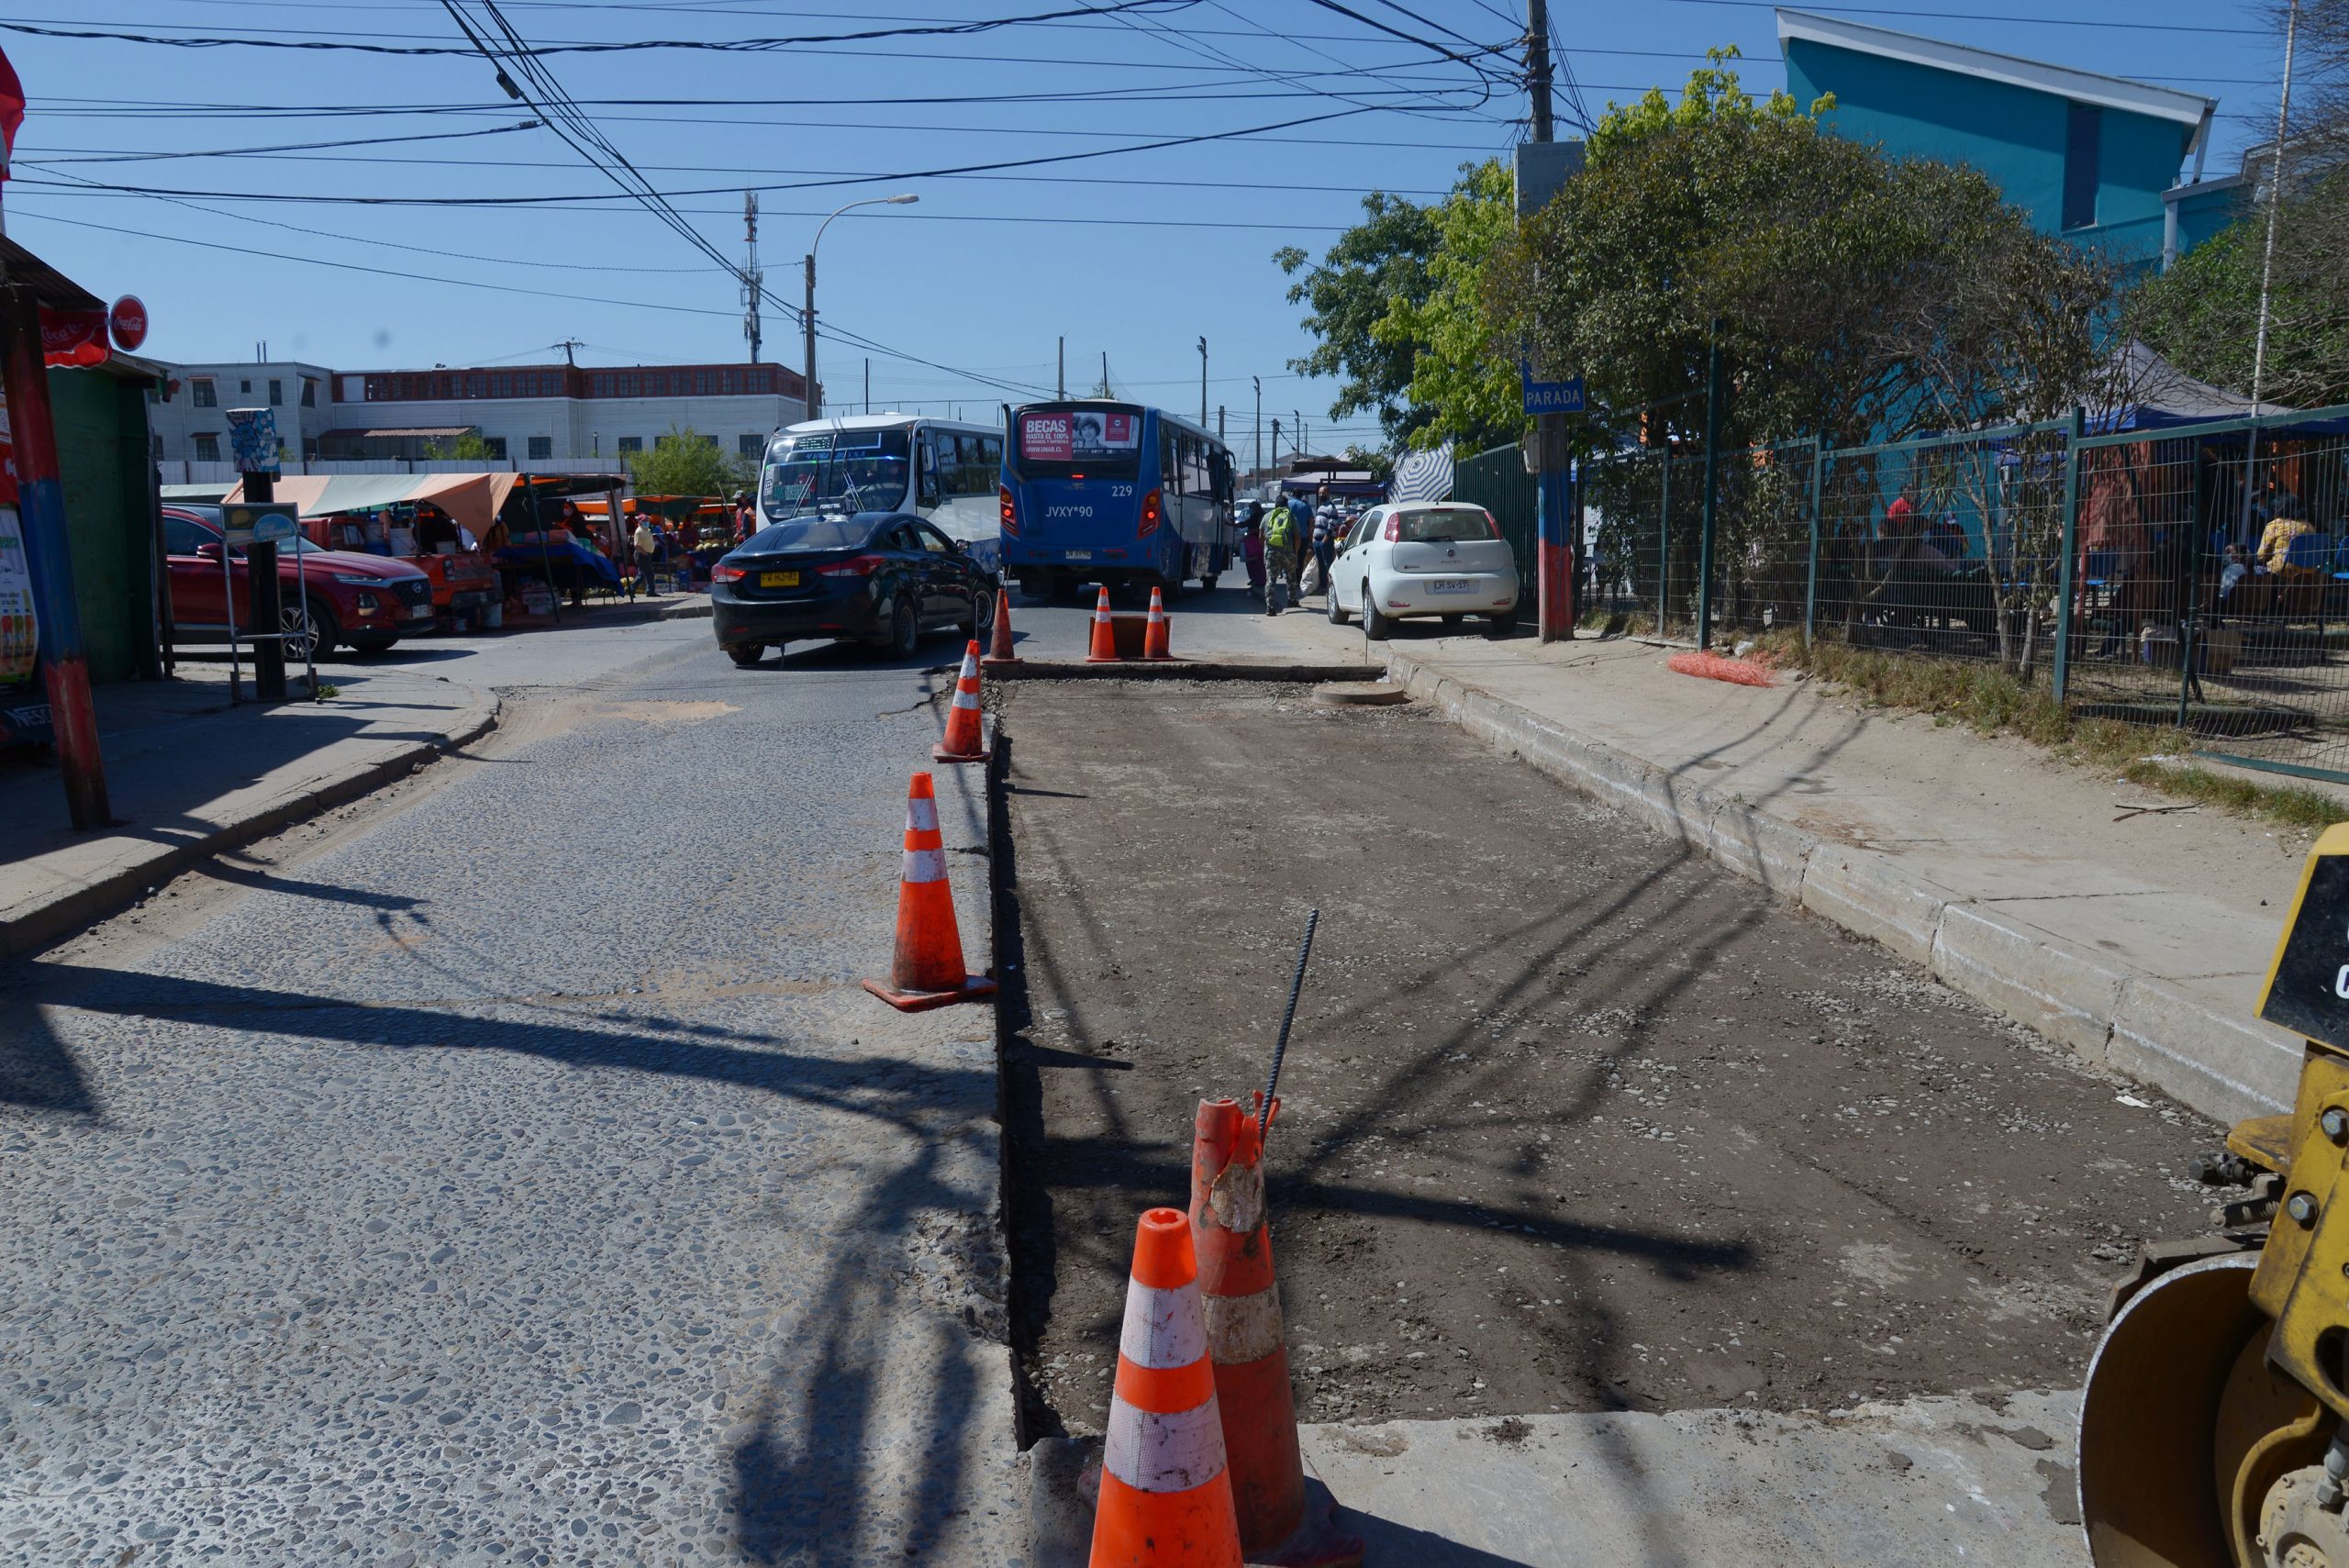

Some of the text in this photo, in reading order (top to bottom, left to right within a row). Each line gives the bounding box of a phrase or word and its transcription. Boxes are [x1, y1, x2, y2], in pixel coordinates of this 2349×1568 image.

[114, 316, 142, 330] Coca-Cola
[1526, 389, 1581, 407] PARADA
[1026, 419, 1066, 433] BECAS
[1111, 485, 1132, 496] 229
